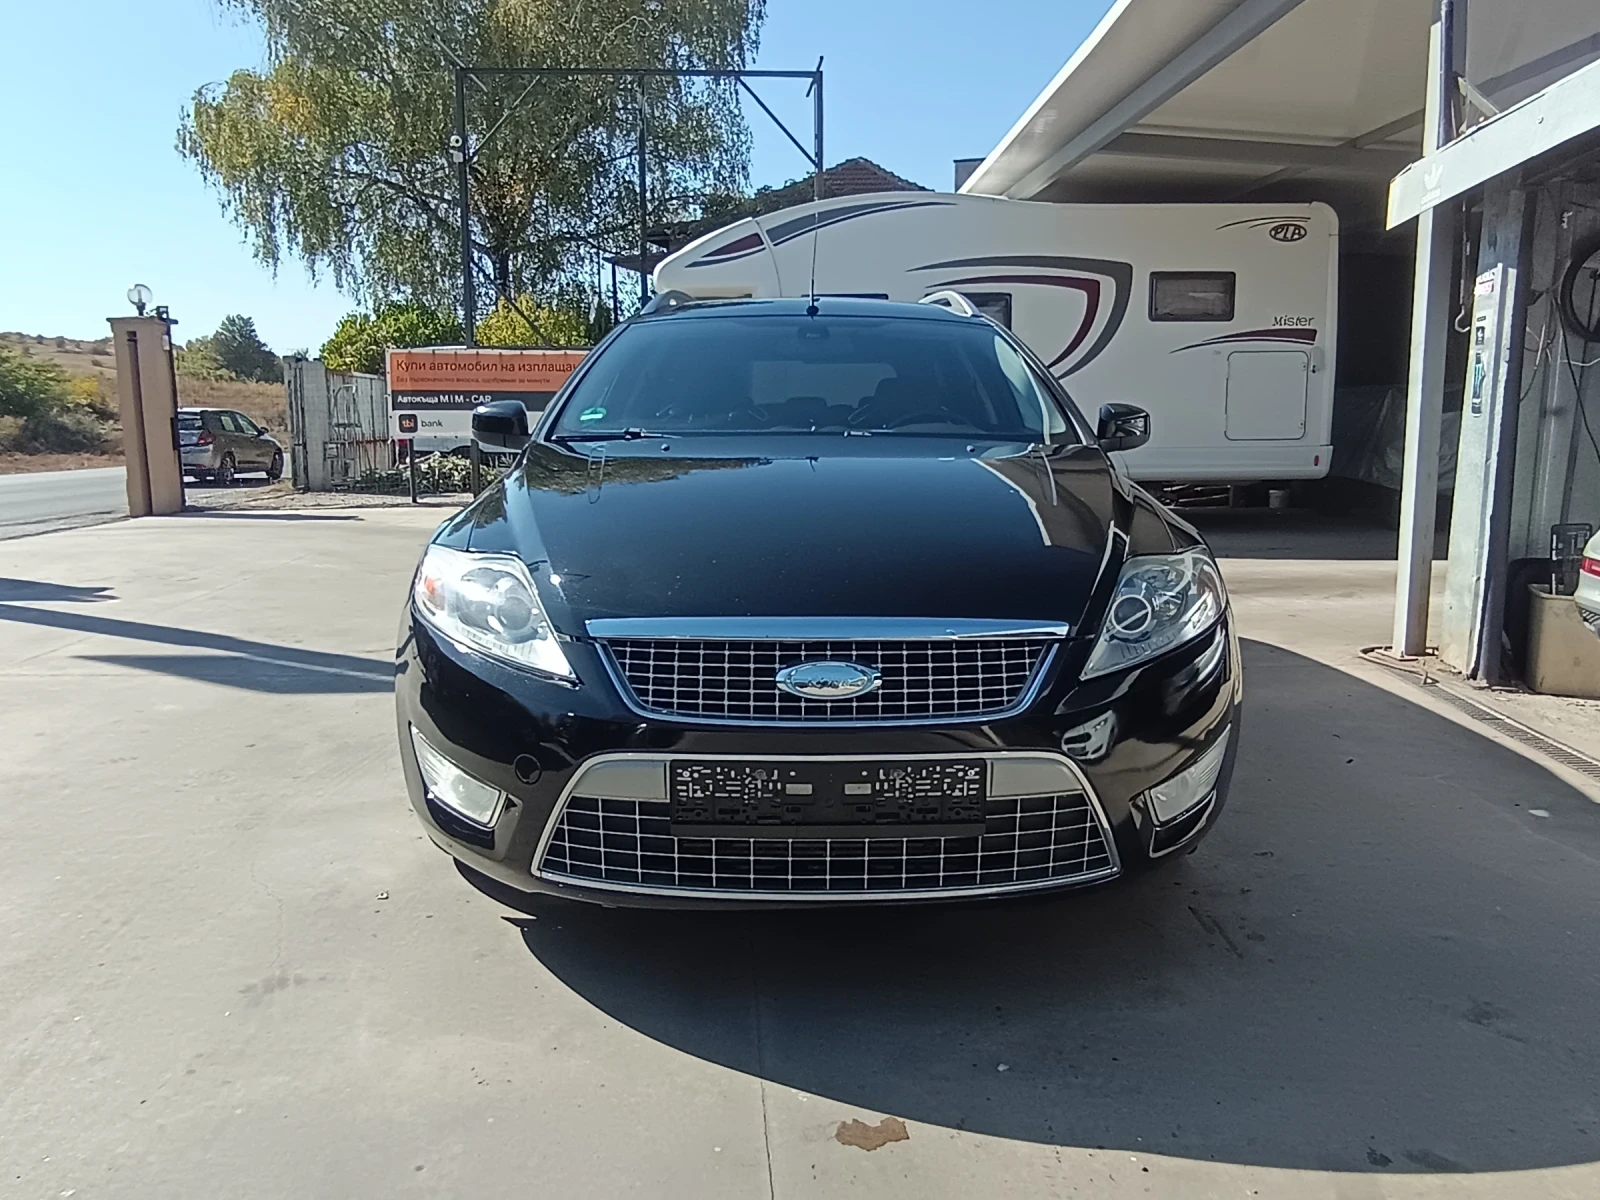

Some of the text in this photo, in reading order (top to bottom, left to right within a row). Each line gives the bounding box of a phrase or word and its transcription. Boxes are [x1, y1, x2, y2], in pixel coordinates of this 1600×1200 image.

[1272, 314, 1315, 327] Mister
[396, 359, 426, 372] Купи
[429, 360, 497, 372] автомобил
[500, 363, 515, 372] на
[397, 395, 438, 404] Автокъща
[471, 394, 492, 404] CAR
[420, 419, 443, 428] bank
